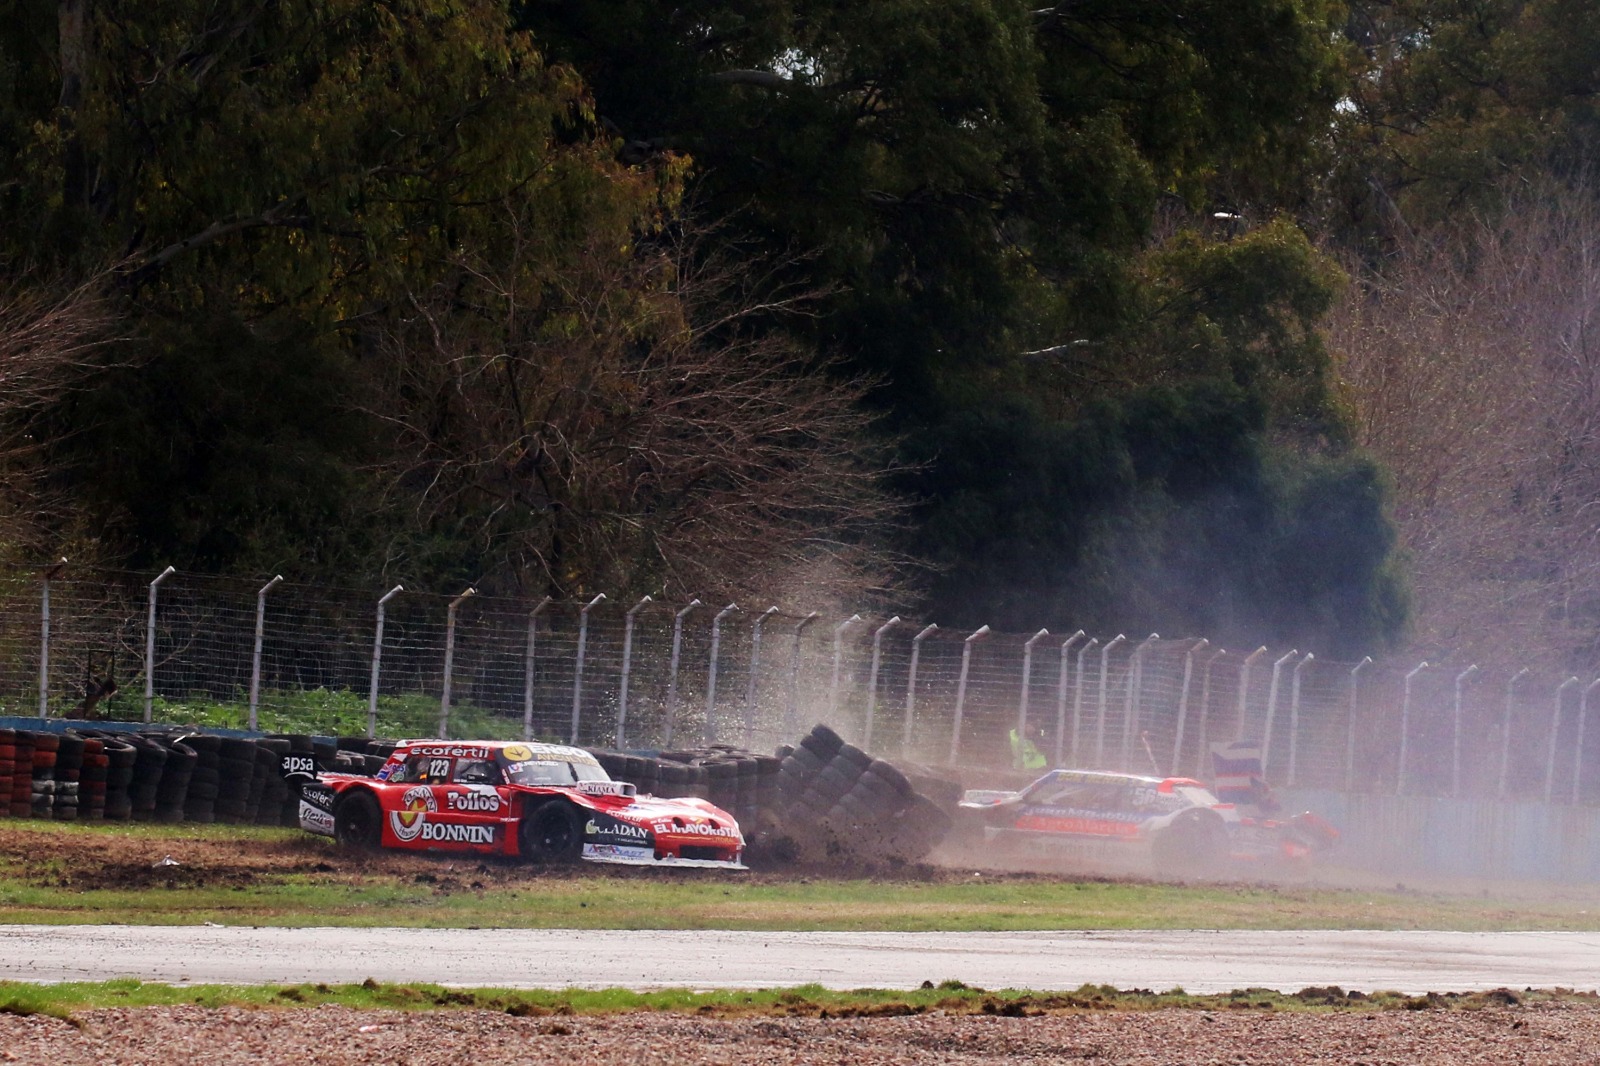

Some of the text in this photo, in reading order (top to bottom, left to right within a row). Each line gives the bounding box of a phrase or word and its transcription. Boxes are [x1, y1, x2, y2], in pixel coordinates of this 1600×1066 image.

[282, 757, 314, 772] apsa
[430, 759, 450, 776] 123
[422, 822, 495, 843] BONNIN
[654, 824, 671, 834] EL
